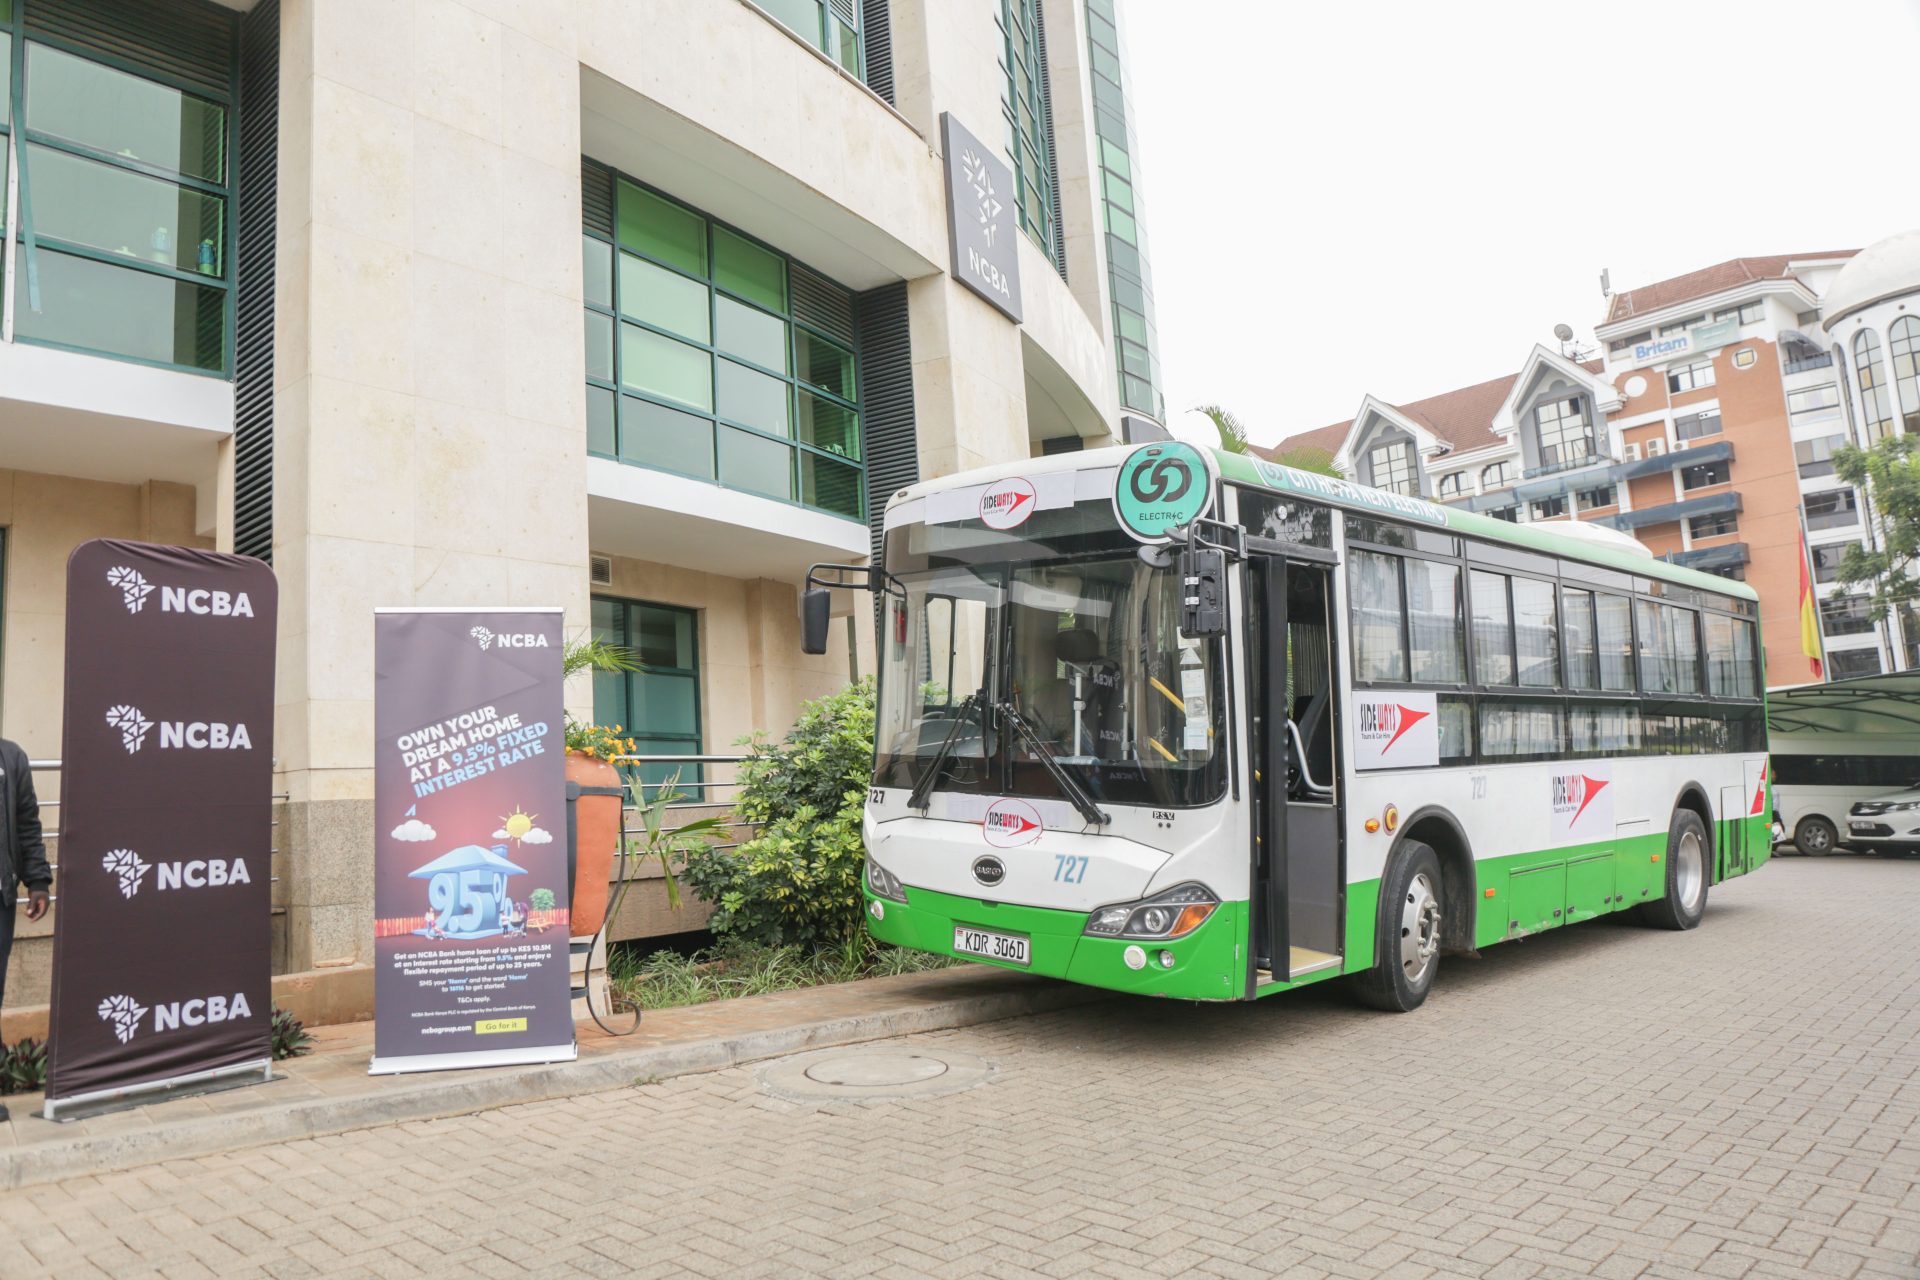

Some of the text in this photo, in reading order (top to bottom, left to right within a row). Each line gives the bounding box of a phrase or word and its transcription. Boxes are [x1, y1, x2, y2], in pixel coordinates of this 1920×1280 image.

[968, 247, 1010, 298] NCBA
[1636, 337, 1688, 360] Britam
[984, 491, 1012, 510] SIDEWAYS
[161, 586, 254, 618] NCBA
[498, 634, 548, 648] NCBA
[398, 706, 498, 750] OWN YOUR
[1360, 704, 1396, 732] SIDE WAYS
[160, 722, 252, 749] NCBA
[402, 714, 522, 768] DREAM HOME
[410, 722, 548, 783] AT A 9.5% FIXED
[414, 740, 544, 798] INTEREST RATE
[1552, 774, 1582, 806] SIDE WAYS
[988, 812, 1018, 828] SIDEWAYS
[158, 858, 251, 890] NCBA
[1054, 854, 1088, 884] 727
[454, 957, 478, 965] starting
[528, 952, 545, 960] enjoy
[966, 932, 1024, 960] KDR 306D
[430, 966, 464, 974] repayment
[466, 964, 487, 973] period
[154, 992, 252, 1032] NCBA
[421, 1025, 472, 1034] ncbagroup.com
